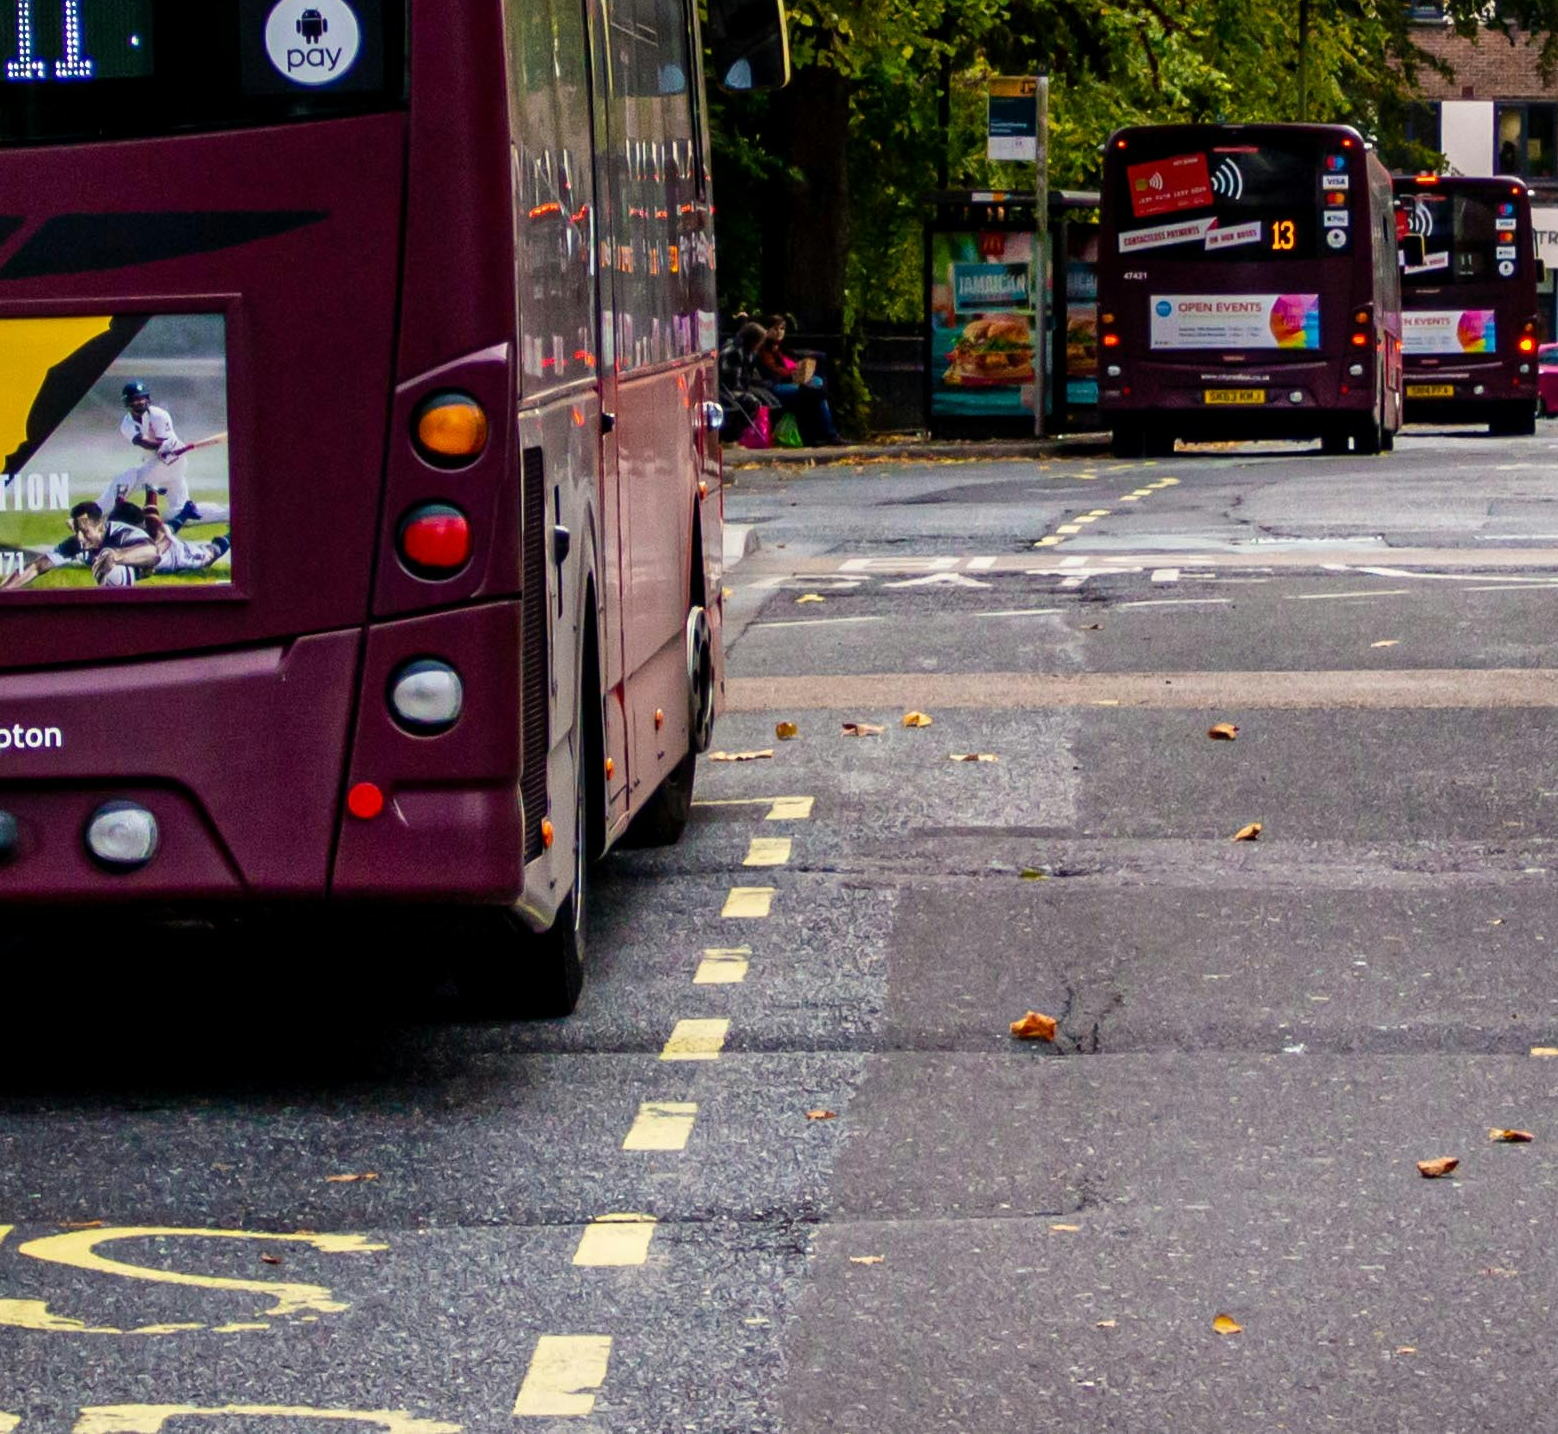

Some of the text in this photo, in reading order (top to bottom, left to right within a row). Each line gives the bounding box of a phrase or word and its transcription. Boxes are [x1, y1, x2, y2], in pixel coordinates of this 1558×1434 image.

[285, 40, 343, 73] pay
[1272, 220, 1295, 250] 13
[1178, 301, 1263, 313] OPEN EVENTS
